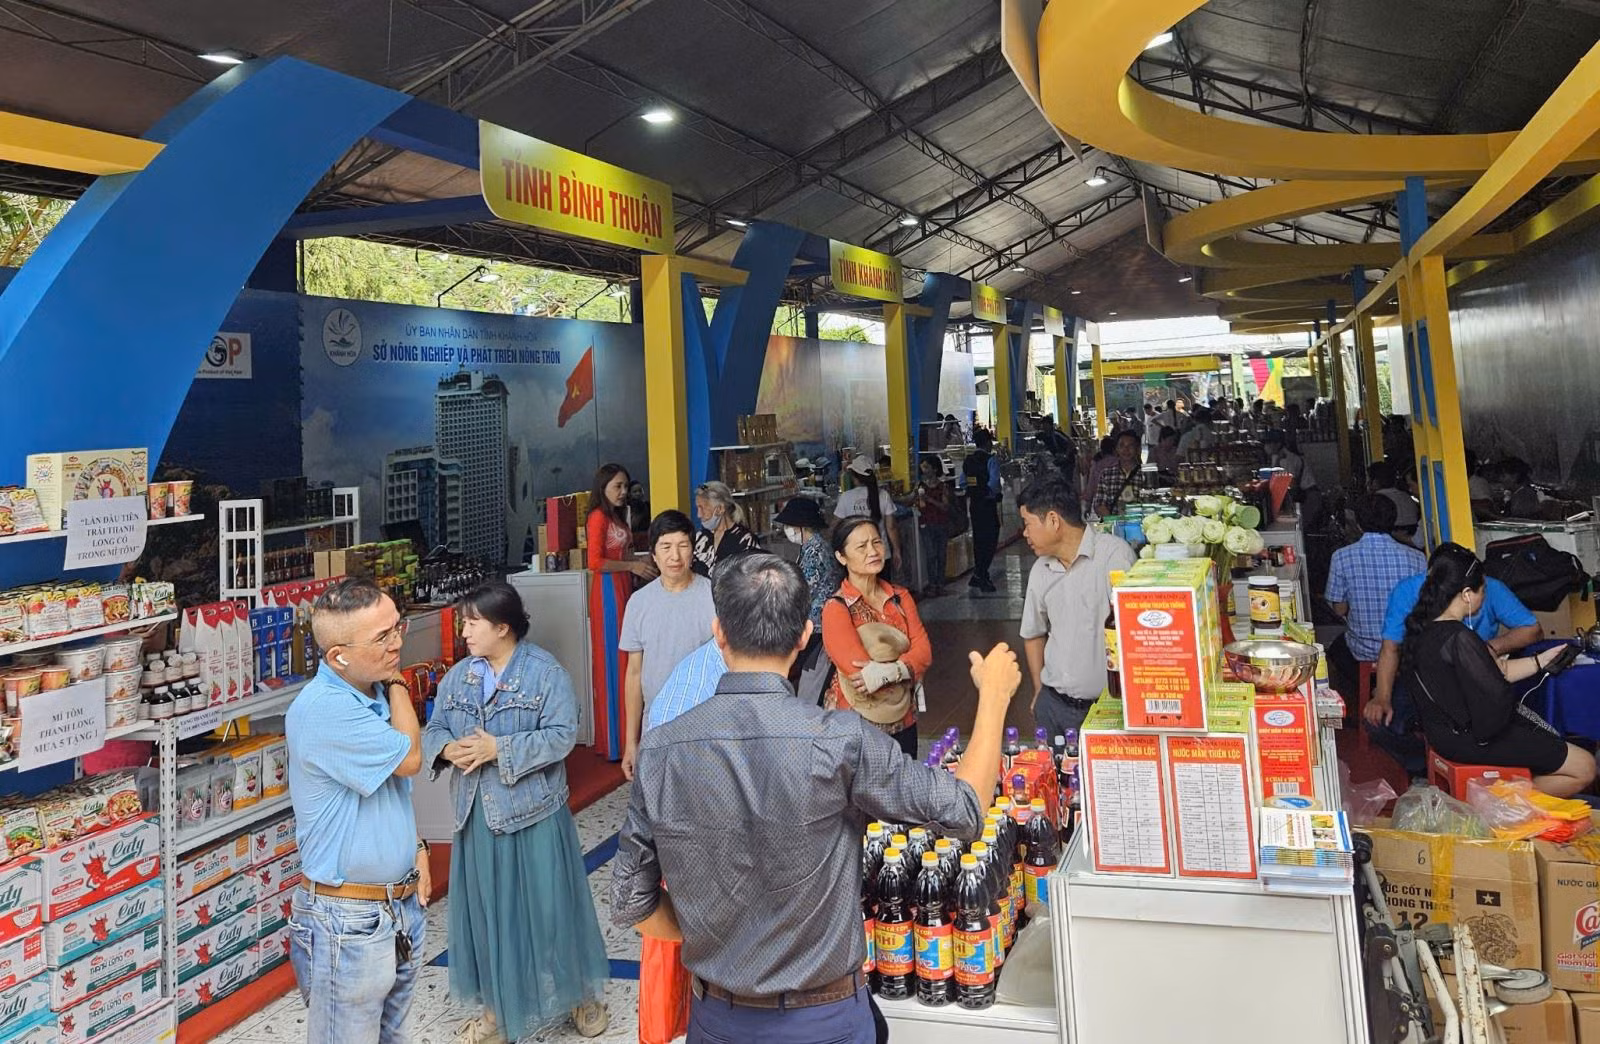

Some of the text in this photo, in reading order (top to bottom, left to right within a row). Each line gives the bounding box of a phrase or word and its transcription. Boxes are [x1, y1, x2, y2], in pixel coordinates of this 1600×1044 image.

[501, 148, 663, 243] TỈNH BÌNH THUẬN
[405, 323, 418, 337] ỦY
[419, 326, 437, 337] BAN
[438, 327, 461, 339] NHÂN
[462, 328, 478, 340] DÂN
[373, 339, 561, 366] SỞ NÔNG NGHIỆP VÀ PHÁT TRIỂN NÔNG THÔN
[121, 511, 139, 522] TIÊN
[107, 524, 134, 535] THANH
[92, 535, 128, 547] LONG CÓ
[77, 550, 106, 560] TRONG
[284, 611, 290, 620] B
[66, 707, 84, 719] TÔM
[39, 717, 95, 739] THANH LONG
[33, 728, 99, 753] MUA 5 TẶNG 1
[1228, 748, 1241, 760] LỘC
[1417, 849, 1426, 865] 6
[1401, 883, 1421, 897] CỐT
[1397, 910, 1429, 931] 12
